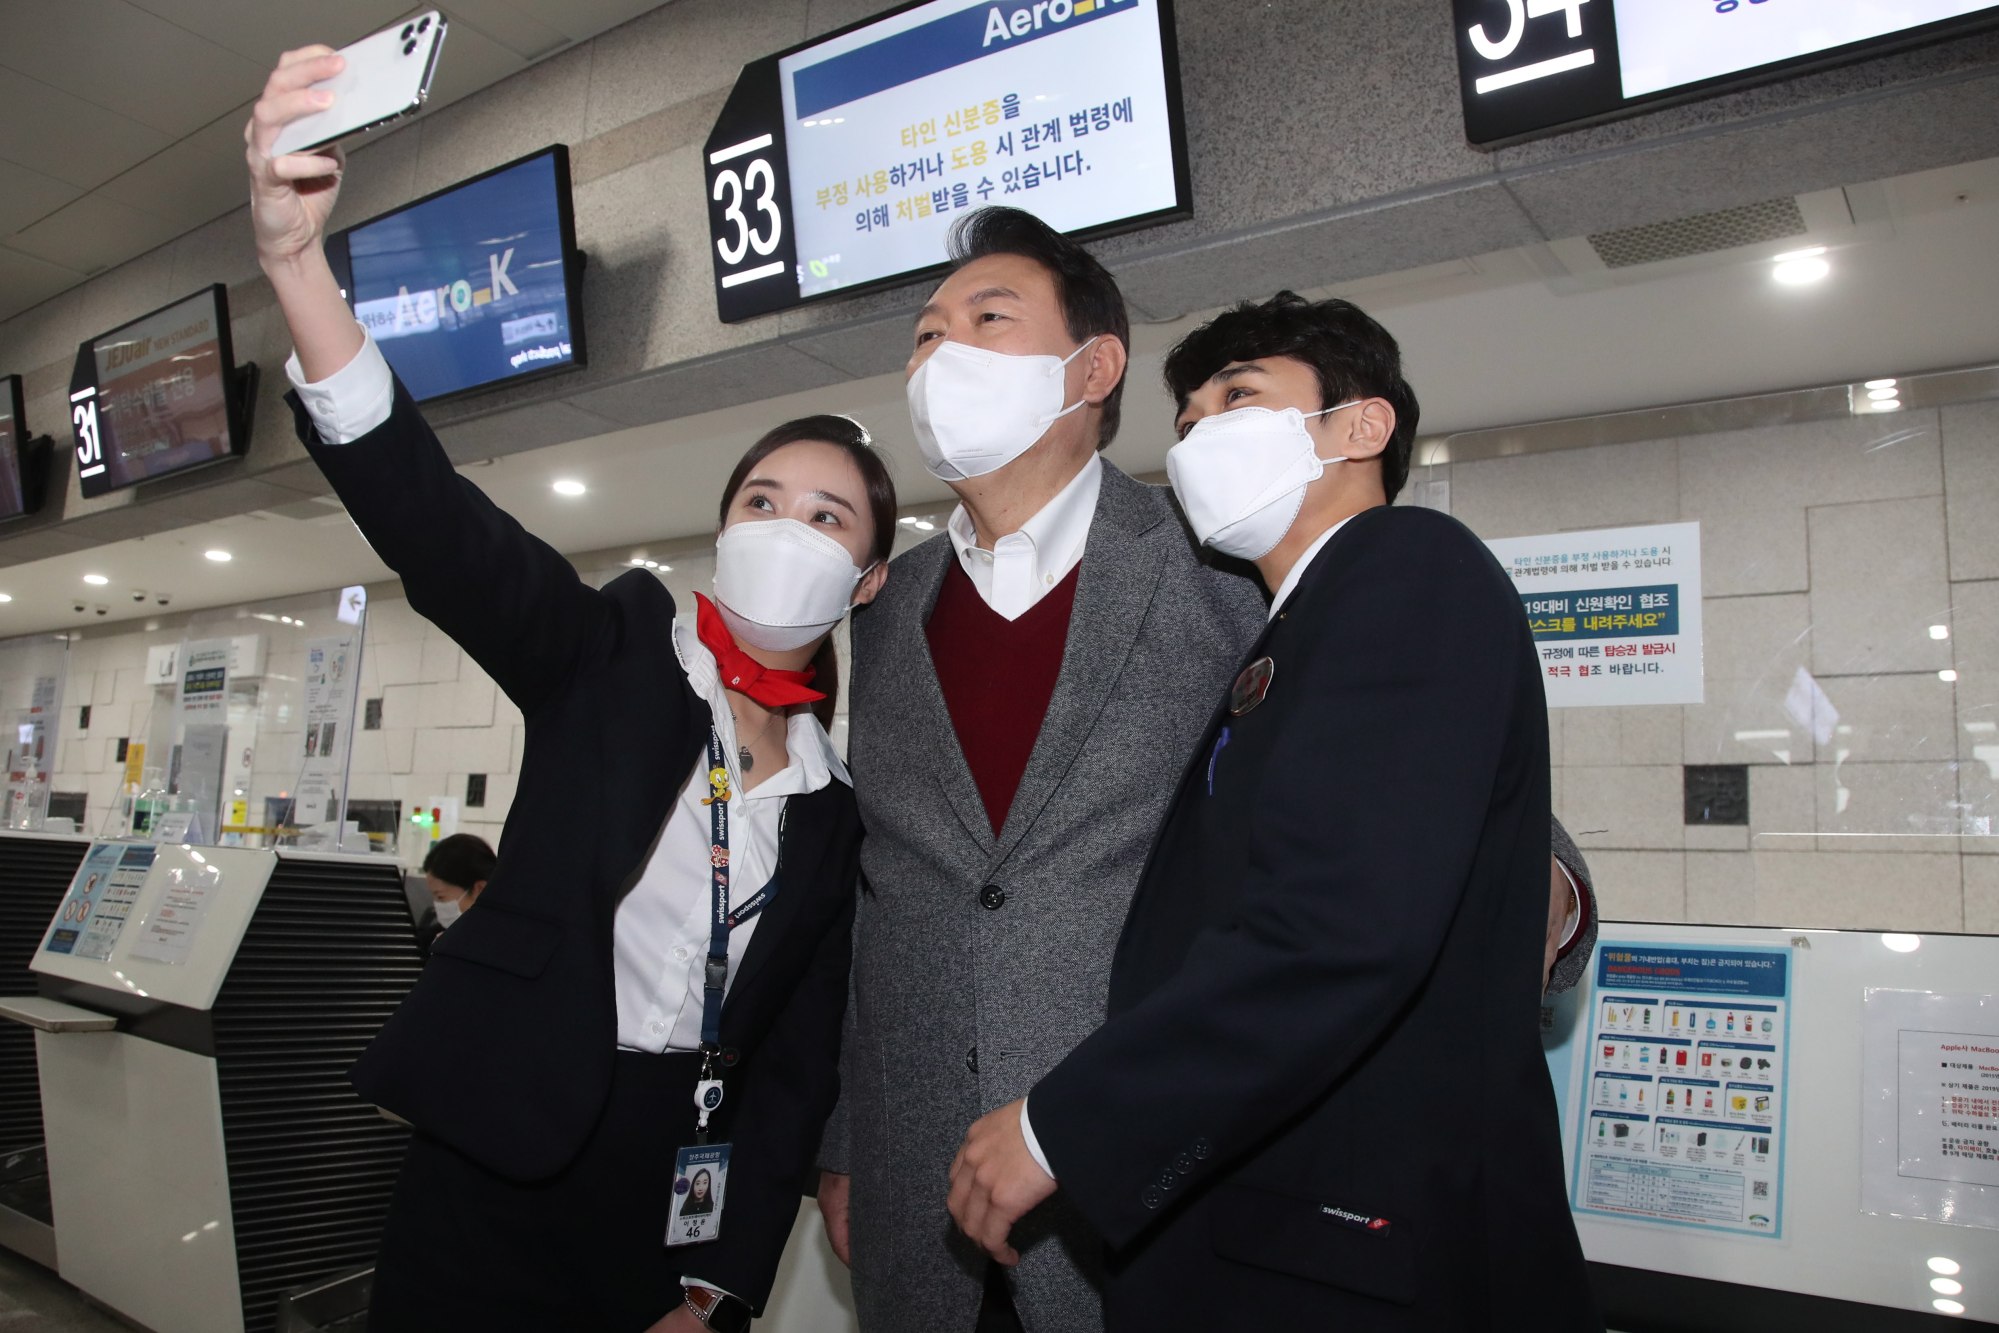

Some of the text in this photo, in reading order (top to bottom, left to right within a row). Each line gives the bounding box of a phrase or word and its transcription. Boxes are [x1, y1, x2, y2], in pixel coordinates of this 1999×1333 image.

[982, 0, 1135, 47] Aero_
[901, 93, 1020, 148] 타인 신분증을
[816, 97, 1133, 210] 부정 사용하거나 도용 시 관계 법령에
[855, 150, 1091, 232] 의해 처벌받을 수 있습니다.
[713, 158, 782, 265] 33
[74, 401, 101, 464] 31
[1514, 546, 1671, 566] 타인 신분증을 부정 사용하거나 도용 시
[1514, 565, 1557, 577] 관계법령에
[1561, 564, 1578, 573] 의해
[1581, 562, 1598, 572] 처벌
[1601, 561, 1619, 571] 받을
[1622, 560, 1631, 569] 수
[1576, 595, 1632, 612] 신원확인
[1639, 593, 1669, 608] 협조
[1542, 642, 1675, 659] 규정에 따른 탑승권 발급시
[1548, 662, 1664, 677] 적극 협조 바랍니다.
[718, 803, 727, 840] swissport
[718, 885, 727, 924] swissport
[734, 892, 766, 919] swissport
[1941, 1044, 1967, 1052] Apple사
[1322, 1206, 1370, 1224] swissport
[686, 1226, 700, 1238] 46
